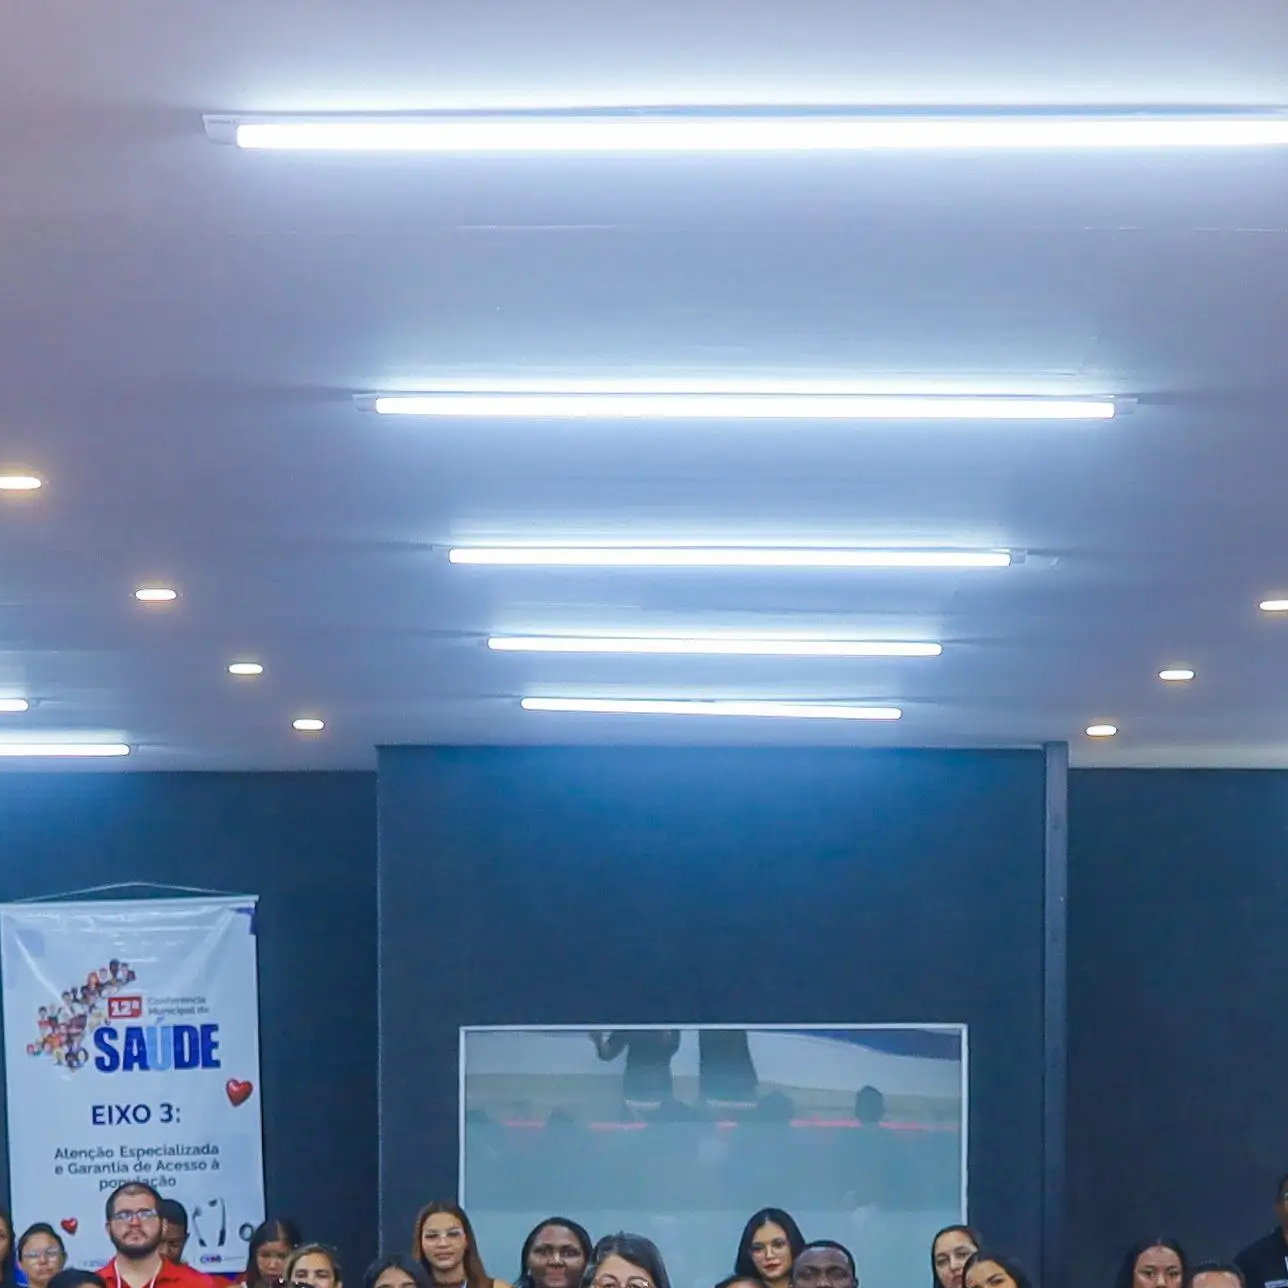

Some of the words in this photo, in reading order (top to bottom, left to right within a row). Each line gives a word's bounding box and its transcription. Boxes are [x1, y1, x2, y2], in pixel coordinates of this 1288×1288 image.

[93, 1016, 221, 1073] SAÚDE
[92, 1104, 151, 1125] EIXO
[159, 1103, 181, 1123] 3:
[54, 1146, 114, 1162] Atenção
[120, 1143, 219, 1160] Especializada
[54, 1165, 63, 1175] e
[67, 1161, 129, 1175] Garantia
[133, 1160, 152, 1172] de
[155, 1159, 208, 1172] Acesso
